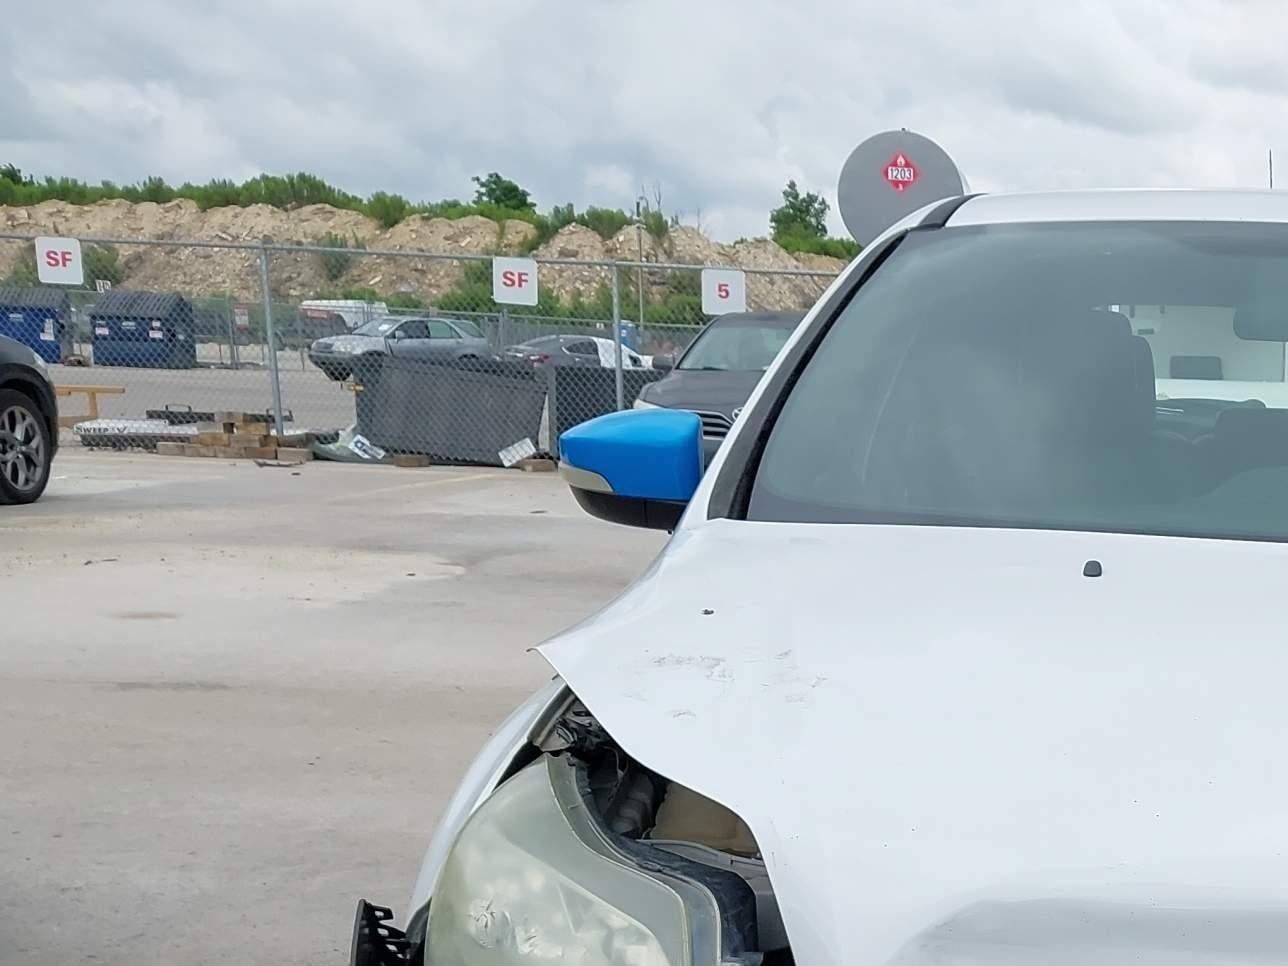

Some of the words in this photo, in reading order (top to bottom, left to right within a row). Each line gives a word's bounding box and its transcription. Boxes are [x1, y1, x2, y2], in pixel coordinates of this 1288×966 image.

[890, 168, 912, 180] 1203
[46, 250, 73, 268] SF
[502, 270, 529, 288] SF
[717, 283, 730, 299] 5
